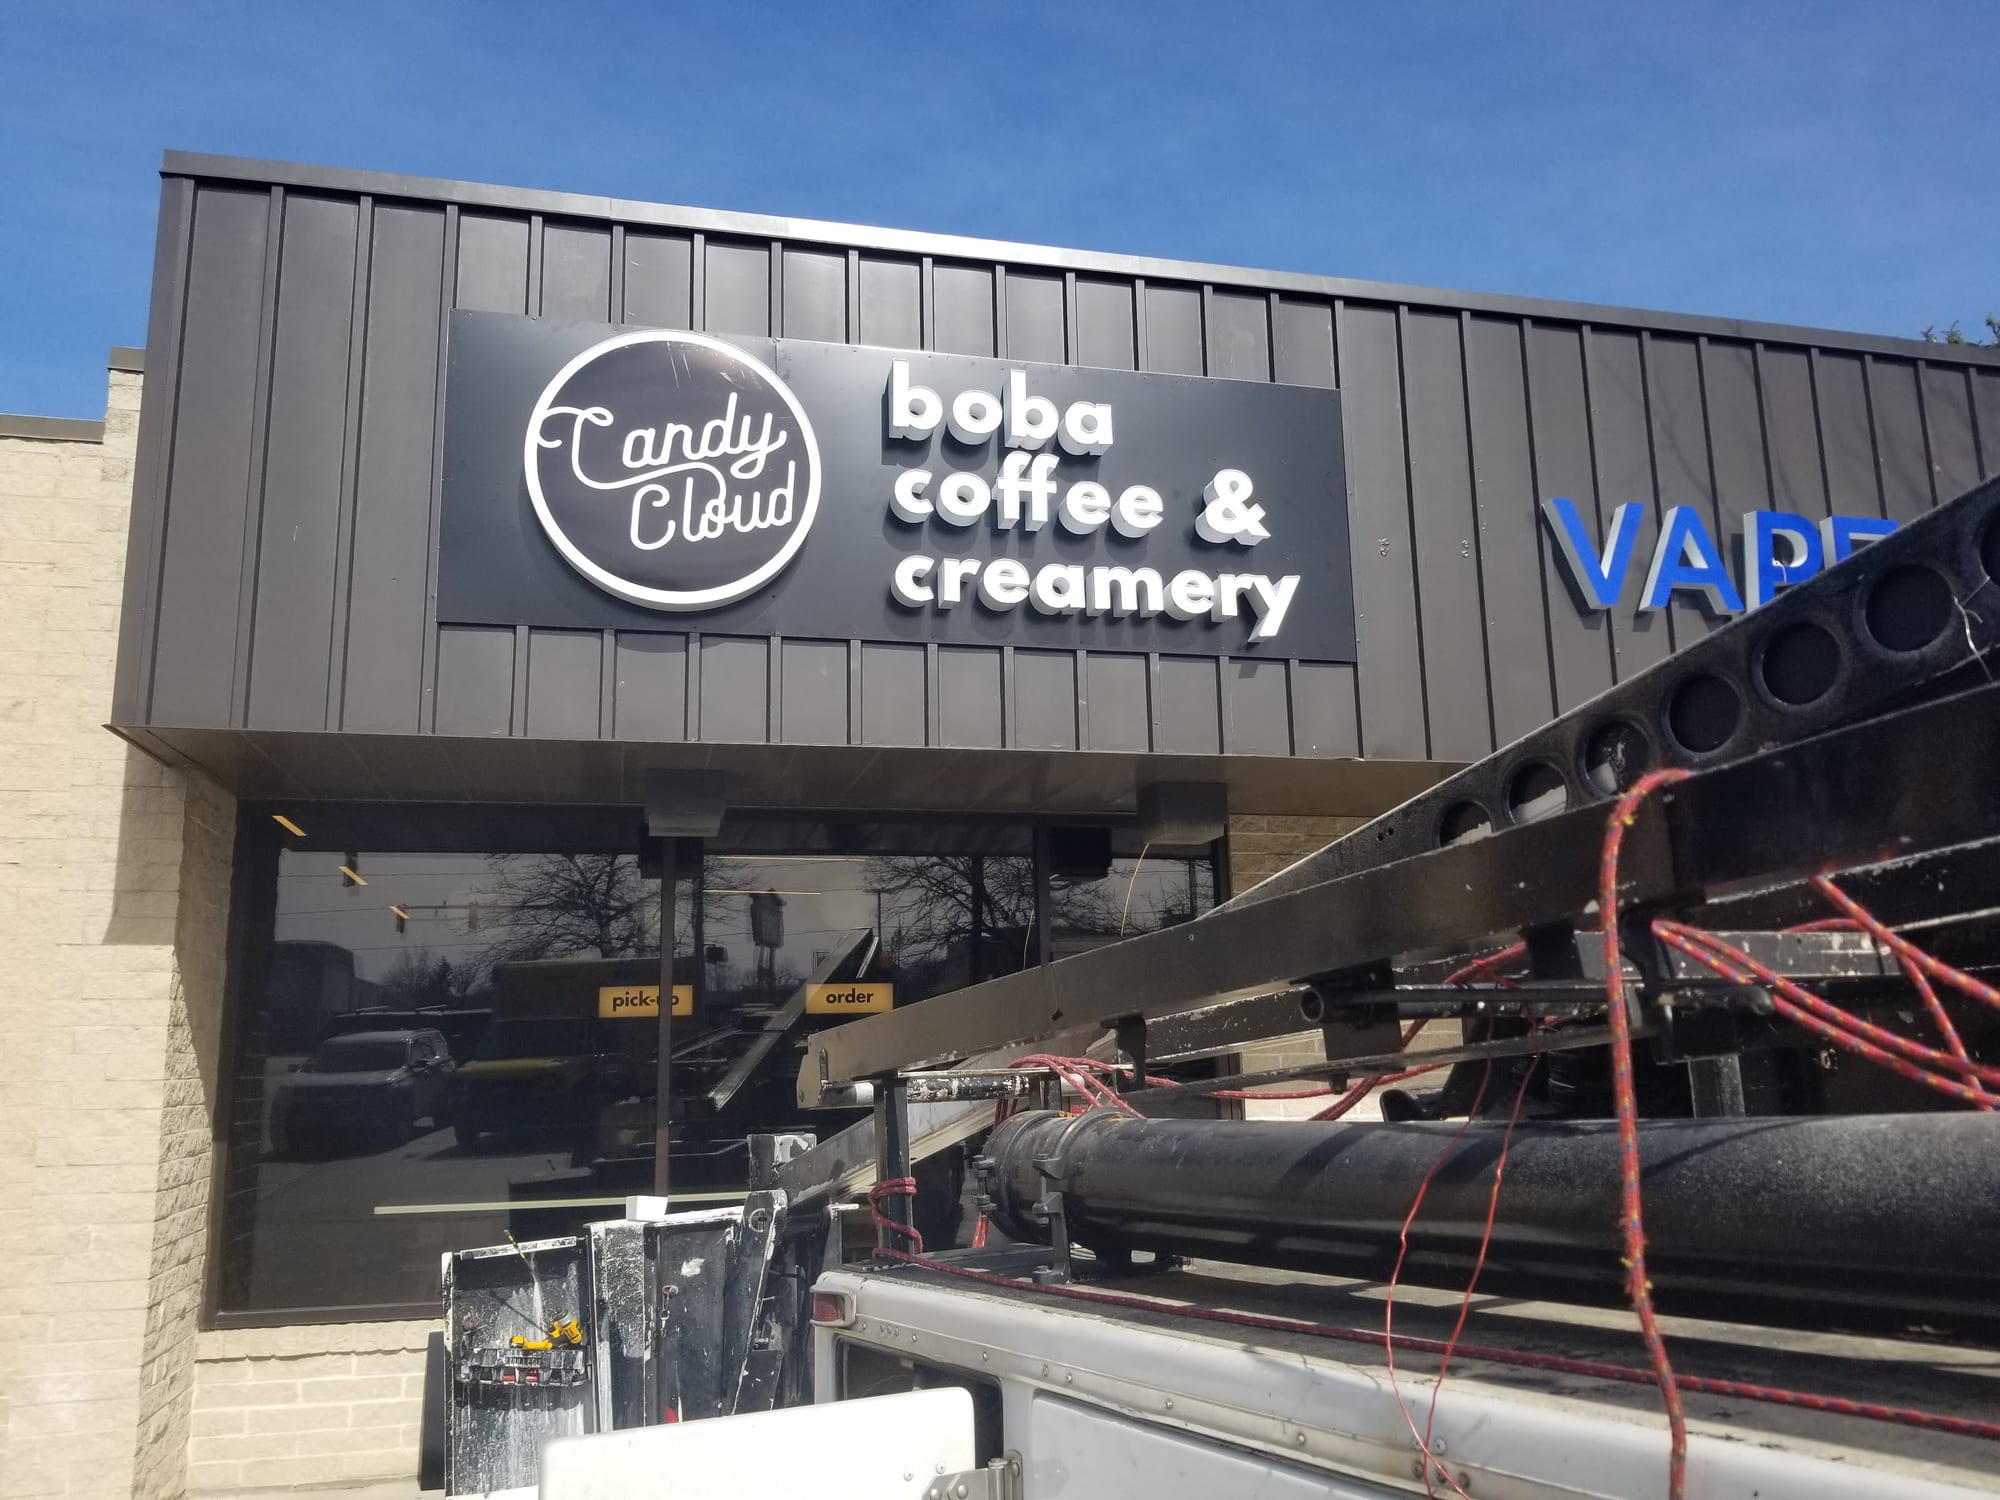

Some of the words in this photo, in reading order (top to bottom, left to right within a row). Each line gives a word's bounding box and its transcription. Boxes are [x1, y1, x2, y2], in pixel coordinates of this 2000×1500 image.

[538, 391, 788, 491] Candy
[889, 360, 1115, 453] boba
[630, 460, 796, 552] Cloud
[891, 451, 1165, 537] coffee
[1196, 467, 1272, 546] &
[891, 555, 1301, 643] creamery
[612, 990, 680, 1012] pick-p
[825, 987, 875, 1005] order
